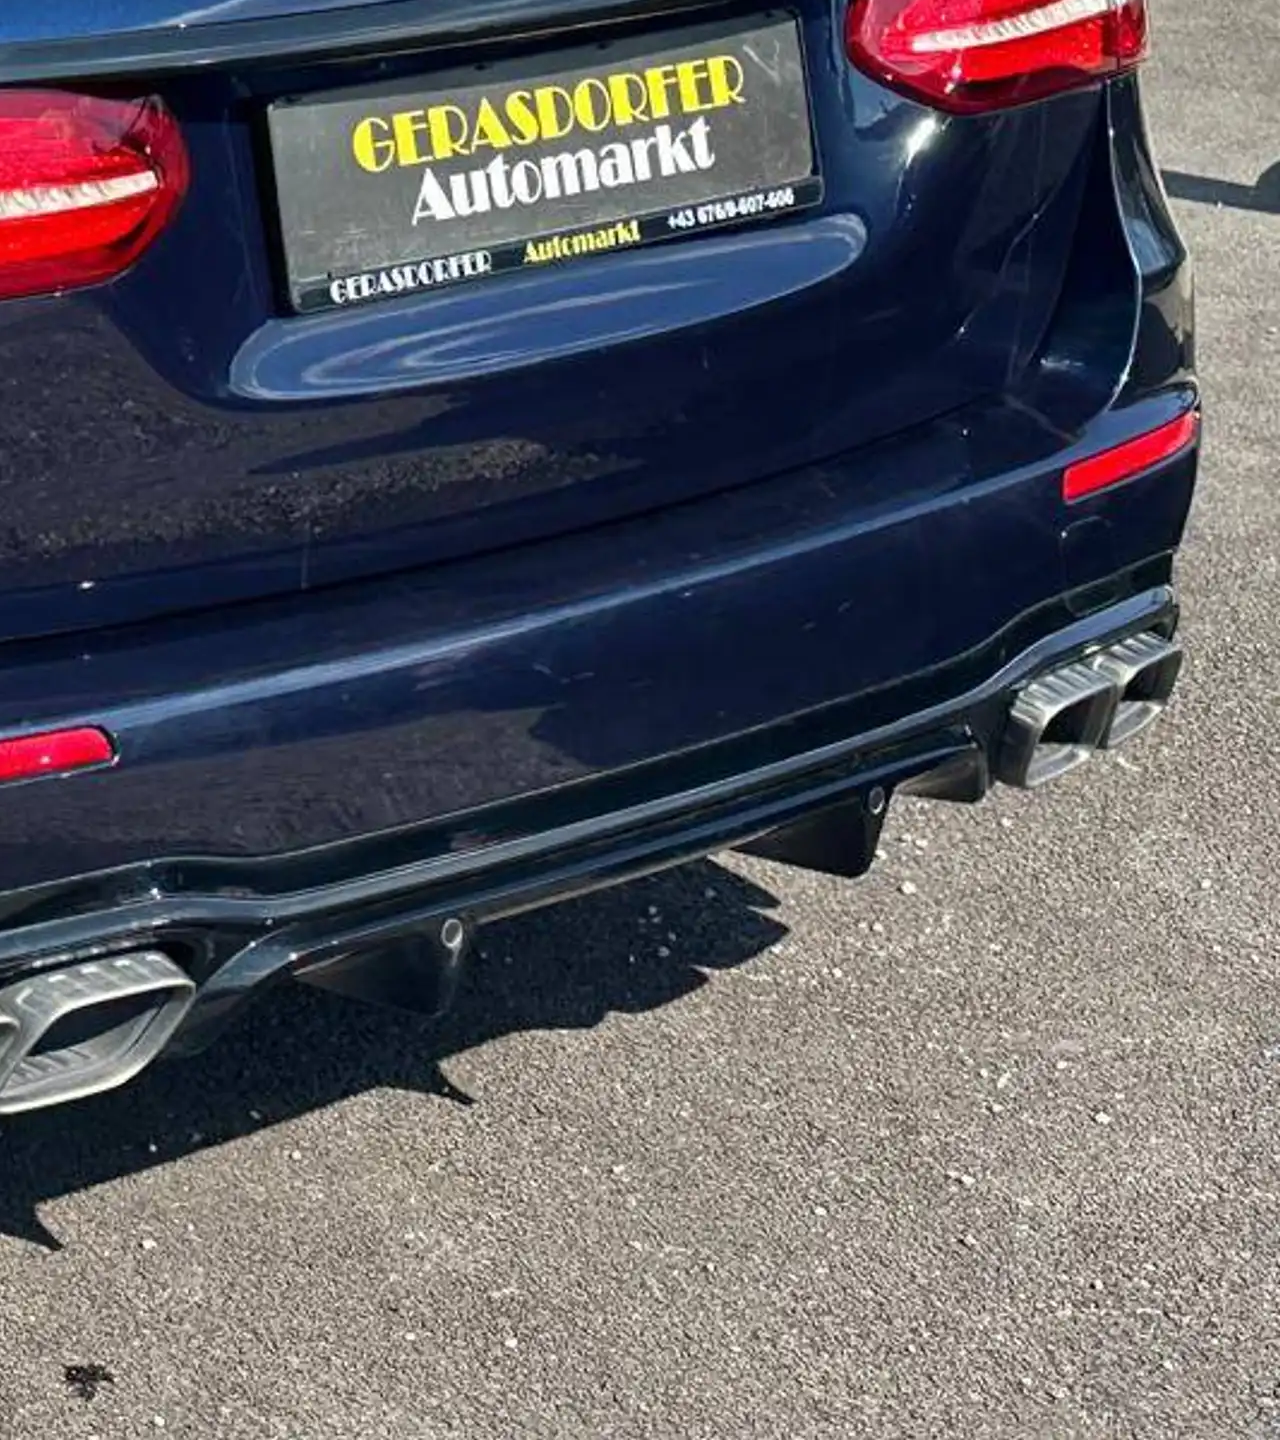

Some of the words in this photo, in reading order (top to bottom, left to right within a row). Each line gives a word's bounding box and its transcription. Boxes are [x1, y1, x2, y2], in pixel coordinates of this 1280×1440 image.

[352, 55, 746, 173] GERASDORFER
[411, 116, 717, 227] Automarkt
[329, 250, 493, 304] GERASDORFER
[522, 218, 641, 265] Automarkt
[667, 208, 696, 229] +43
